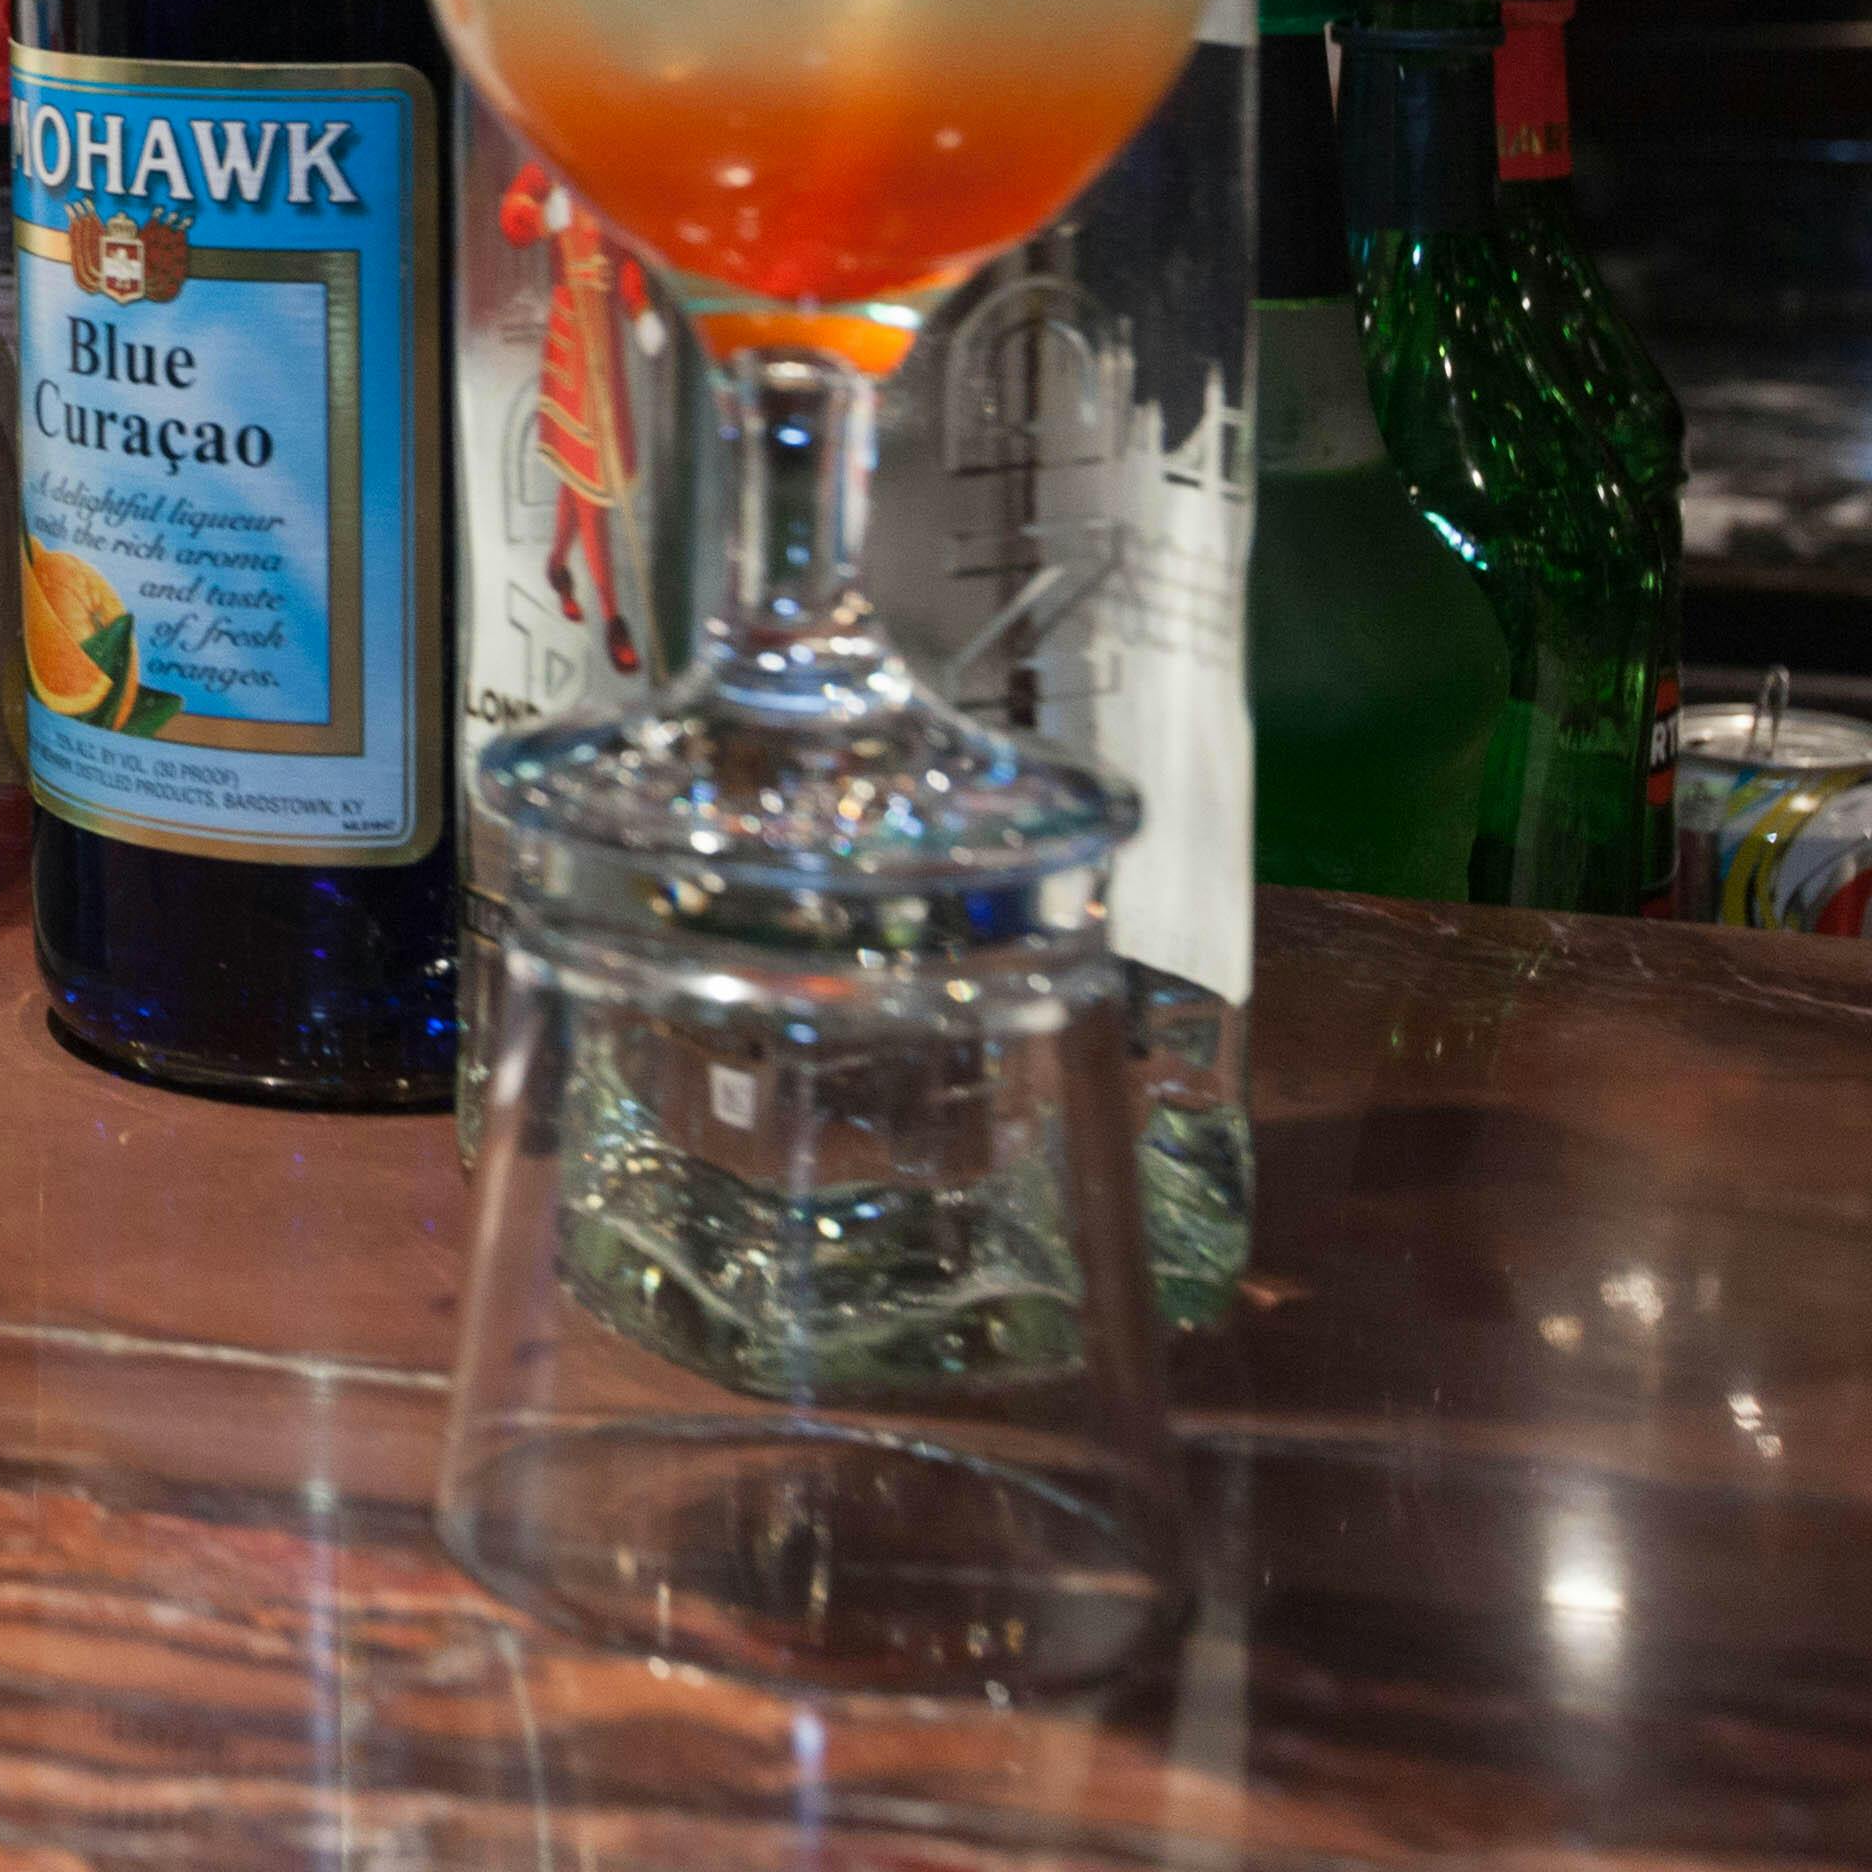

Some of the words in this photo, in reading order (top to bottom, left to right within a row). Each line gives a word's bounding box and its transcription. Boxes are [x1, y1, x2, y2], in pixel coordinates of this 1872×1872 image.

[67, 314, 197, 389] Blue
[34, 377, 275, 476] Curaçao
[168, 497, 286, 540] liqueur
[112, 531, 166, 562] rich
[175, 548, 284, 573] aroma
[138, 574, 204, 603] and
[206, 584, 286, 612] taste
[149, 612, 200, 649] of
[179, 614, 285, 654] fresh
[146, 656, 281, 694] oranges.
